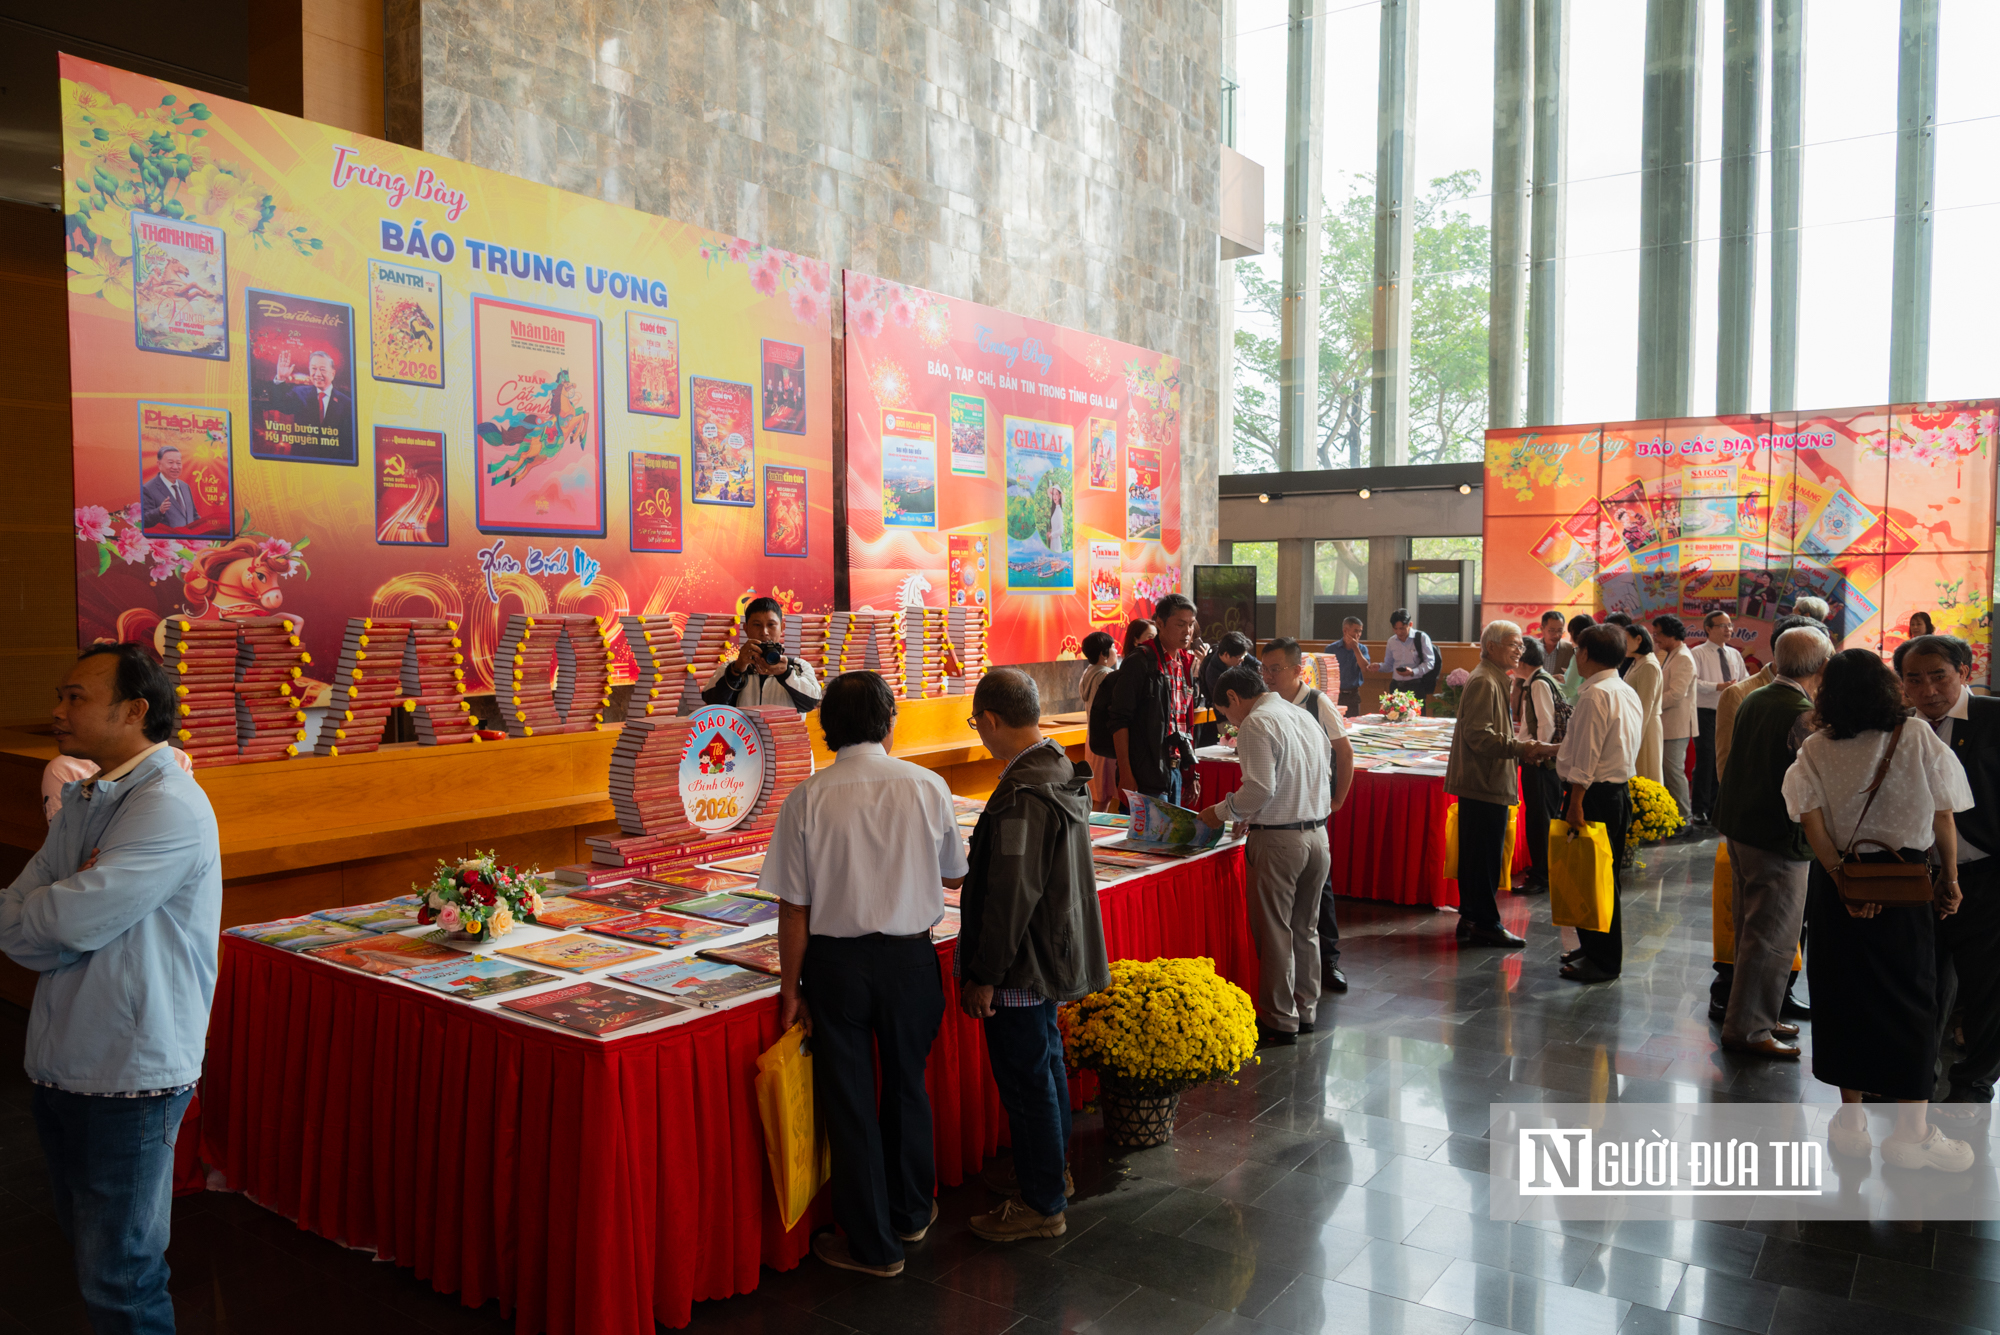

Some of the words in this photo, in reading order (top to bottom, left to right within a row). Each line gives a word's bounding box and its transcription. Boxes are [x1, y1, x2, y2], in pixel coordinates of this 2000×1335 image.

[332, 146, 410, 207] Trưng
[415, 168, 467, 220] Bày
[381, 220, 455, 262] BÁO
[465, 238, 576, 289] TRUNG
[585, 266, 669, 308] ƯƠNG
[510, 320, 541, 339] Nhân
[542, 325, 565, 344] Dân
[399, 360, 437, 380] 2026
[927, 359, 952, 381] BÁO,
[955, 366, 974, 385] TẠP
[977, 370, 996, 389] CHÍ,
[999, 372, 1018, 391] BẢN
[1021, 379, 1035, 394] TIN
[1038, 383, 1066, 400] TRONG
[1069, 385, 1087, 404] TỈNH
[1089, 393, 1103, 407] GIA
[1105, 396, 1118, 410] LAI
[264, 419, 292, 433] Vững
[294, 422, 319, 434] bước
[321, 424, 339, 436] vào
[282, 433, 318, 445] nguyên
[320, 435, 339, 446] mới
[1014, 428, 1039, 450] GIA
[1041, 432, 1063, 453] LAI
[1510, 432, 1574, 466] Trưng
[1578, 428, 1629, 464] Bày
[1636, 438, 1673, 456] BÁO
[1681, 436, 1715, 454] CÁC
[1723, 438, 1752, 457] ĐỊA
[1760, 432, 1834, 450] PHƯƠNG
[527, 547, 568, 574] Bính
[574, 547, 600, 586] Ngọ
[1712, 573, 1736, 588] XV
[697, 713, 725, 734] BÁO
[727, 717, 758, 756] XUÂN
[710, 742, 725, 756] Tết
[687, 778, 718, 792] Bính
[720, 776, 745, 793] Ngọ
[695, 796, 739, 822] 2026
